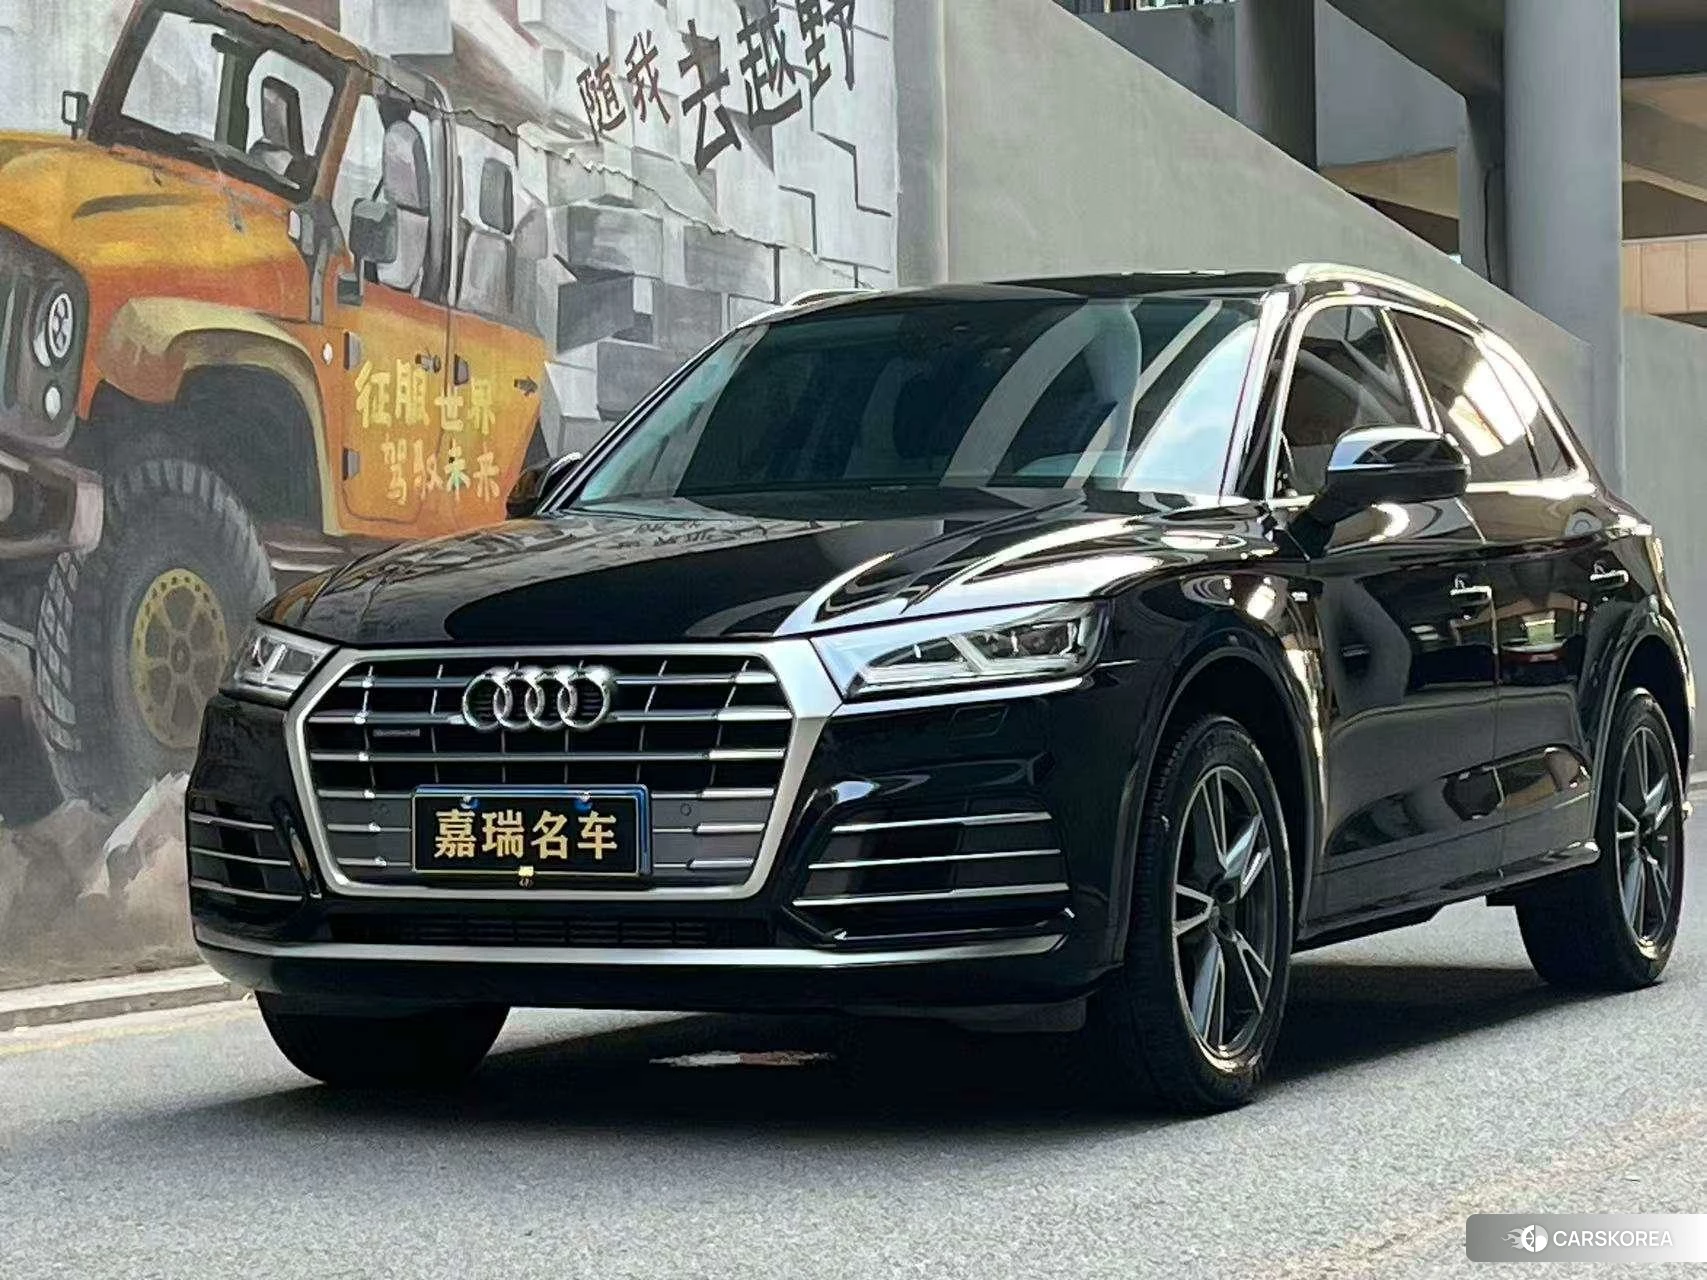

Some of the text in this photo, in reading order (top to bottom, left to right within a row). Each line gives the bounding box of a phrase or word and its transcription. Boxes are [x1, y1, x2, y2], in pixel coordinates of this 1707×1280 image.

[354, 358, 496, 435] 征服世界
[434, 808, 618, 860] 嘉瑞名车
